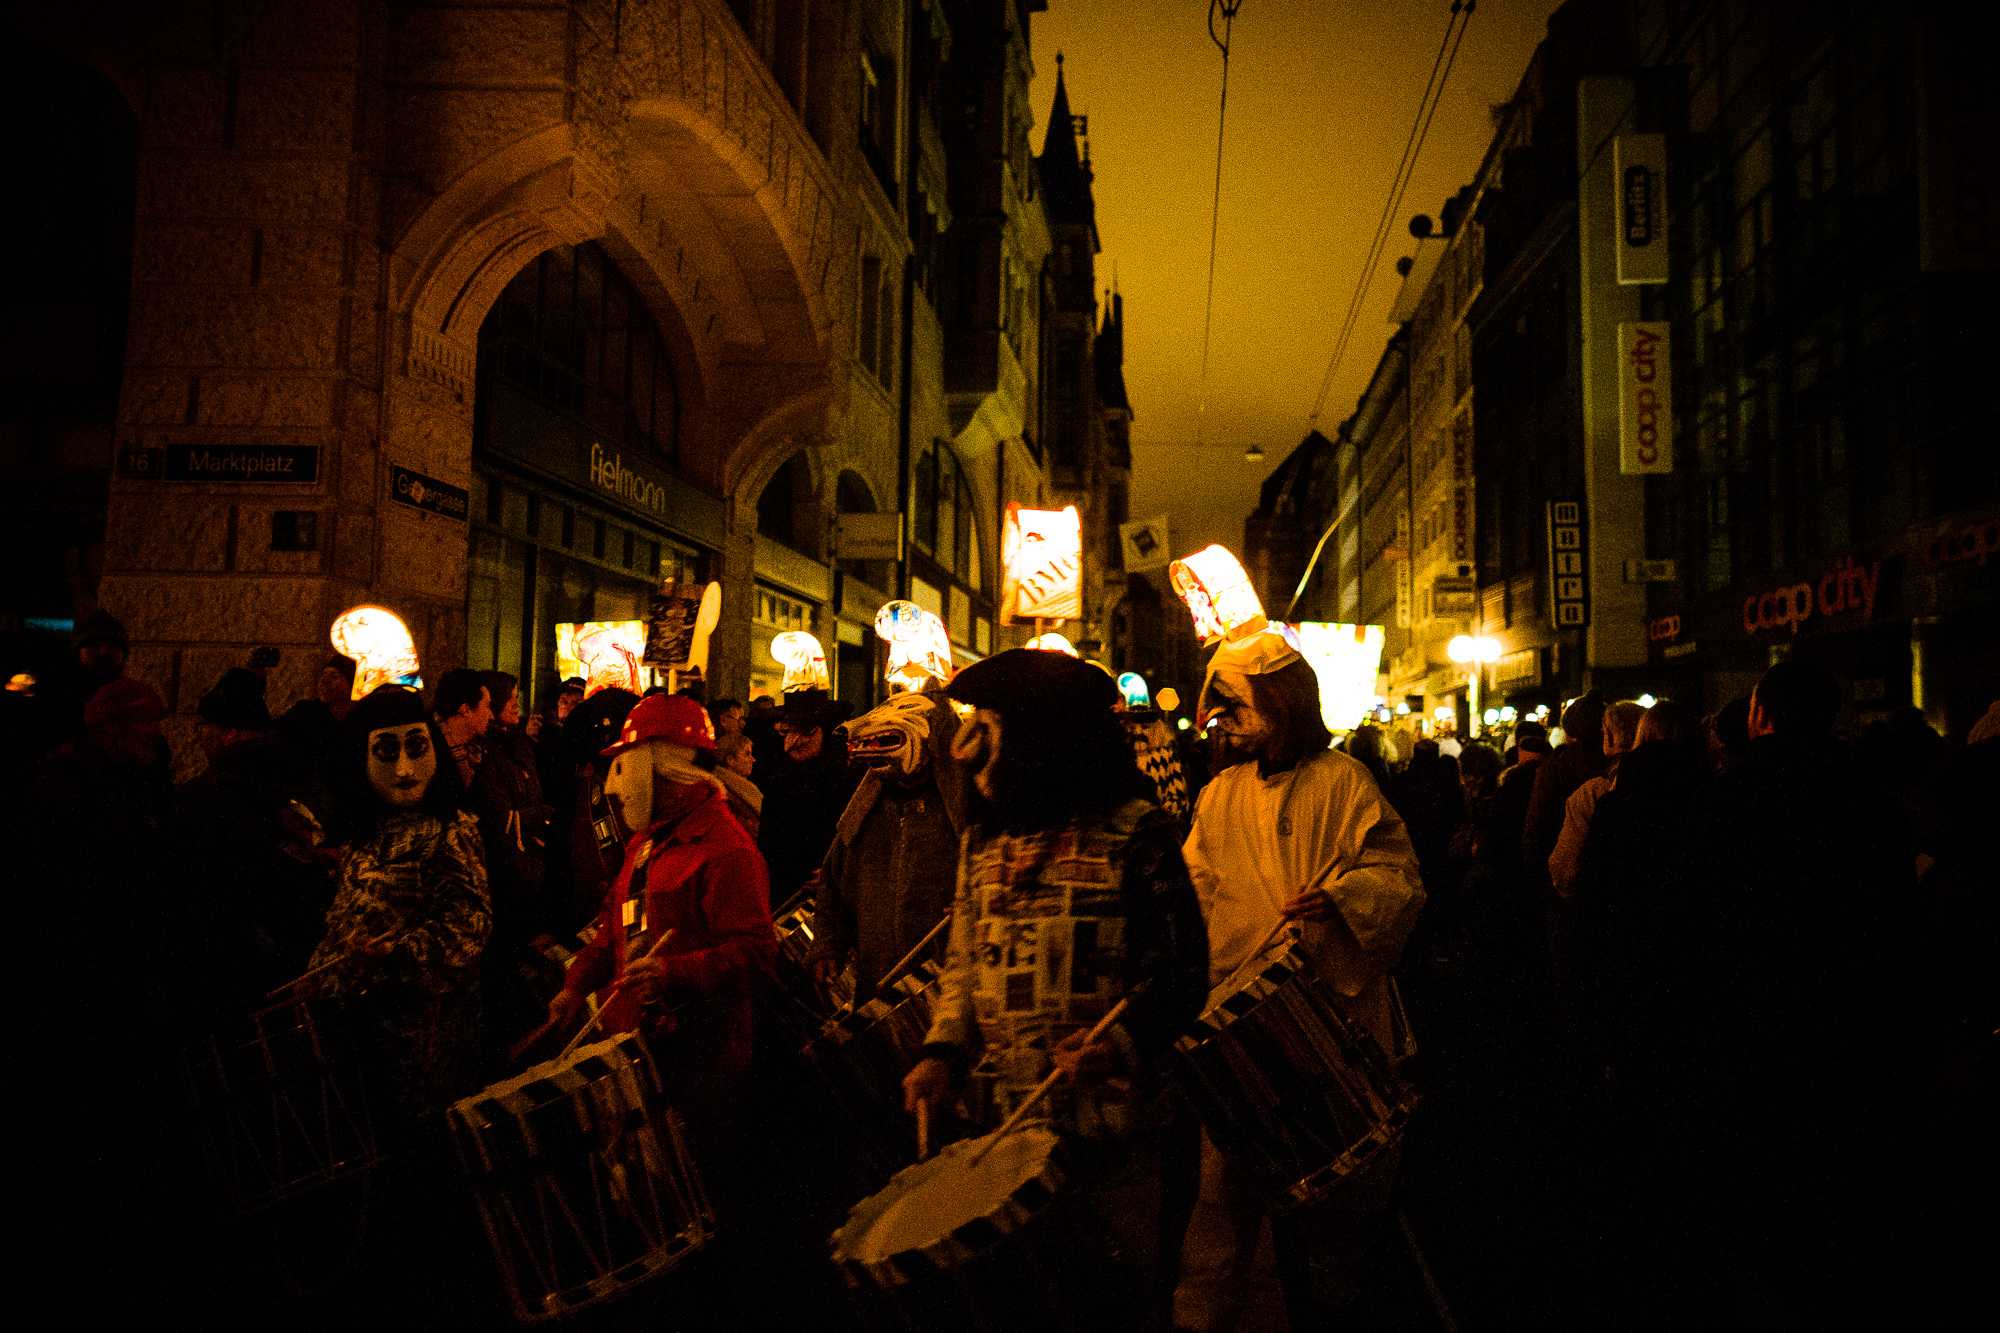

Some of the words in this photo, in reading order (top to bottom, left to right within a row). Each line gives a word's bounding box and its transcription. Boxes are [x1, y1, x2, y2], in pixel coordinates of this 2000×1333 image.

[1627, 173, 1646, 239] Berlitz
[1630, 329, 1661, 383] city
[1638, 388, 1662, 465] coop
[128, 453, 149, 472] 16
[188, 450, 294, 479] Marktplatz
[590, 442, 665, 516] fielmann
[398, 473, 466, 513] Geergasse
[1926, 521, 2000, 567] coop
[1743, 582, 1813, 635] coop
[1818, 555, 1881, 622] city
[1650, 614, 1680, 641] coop
